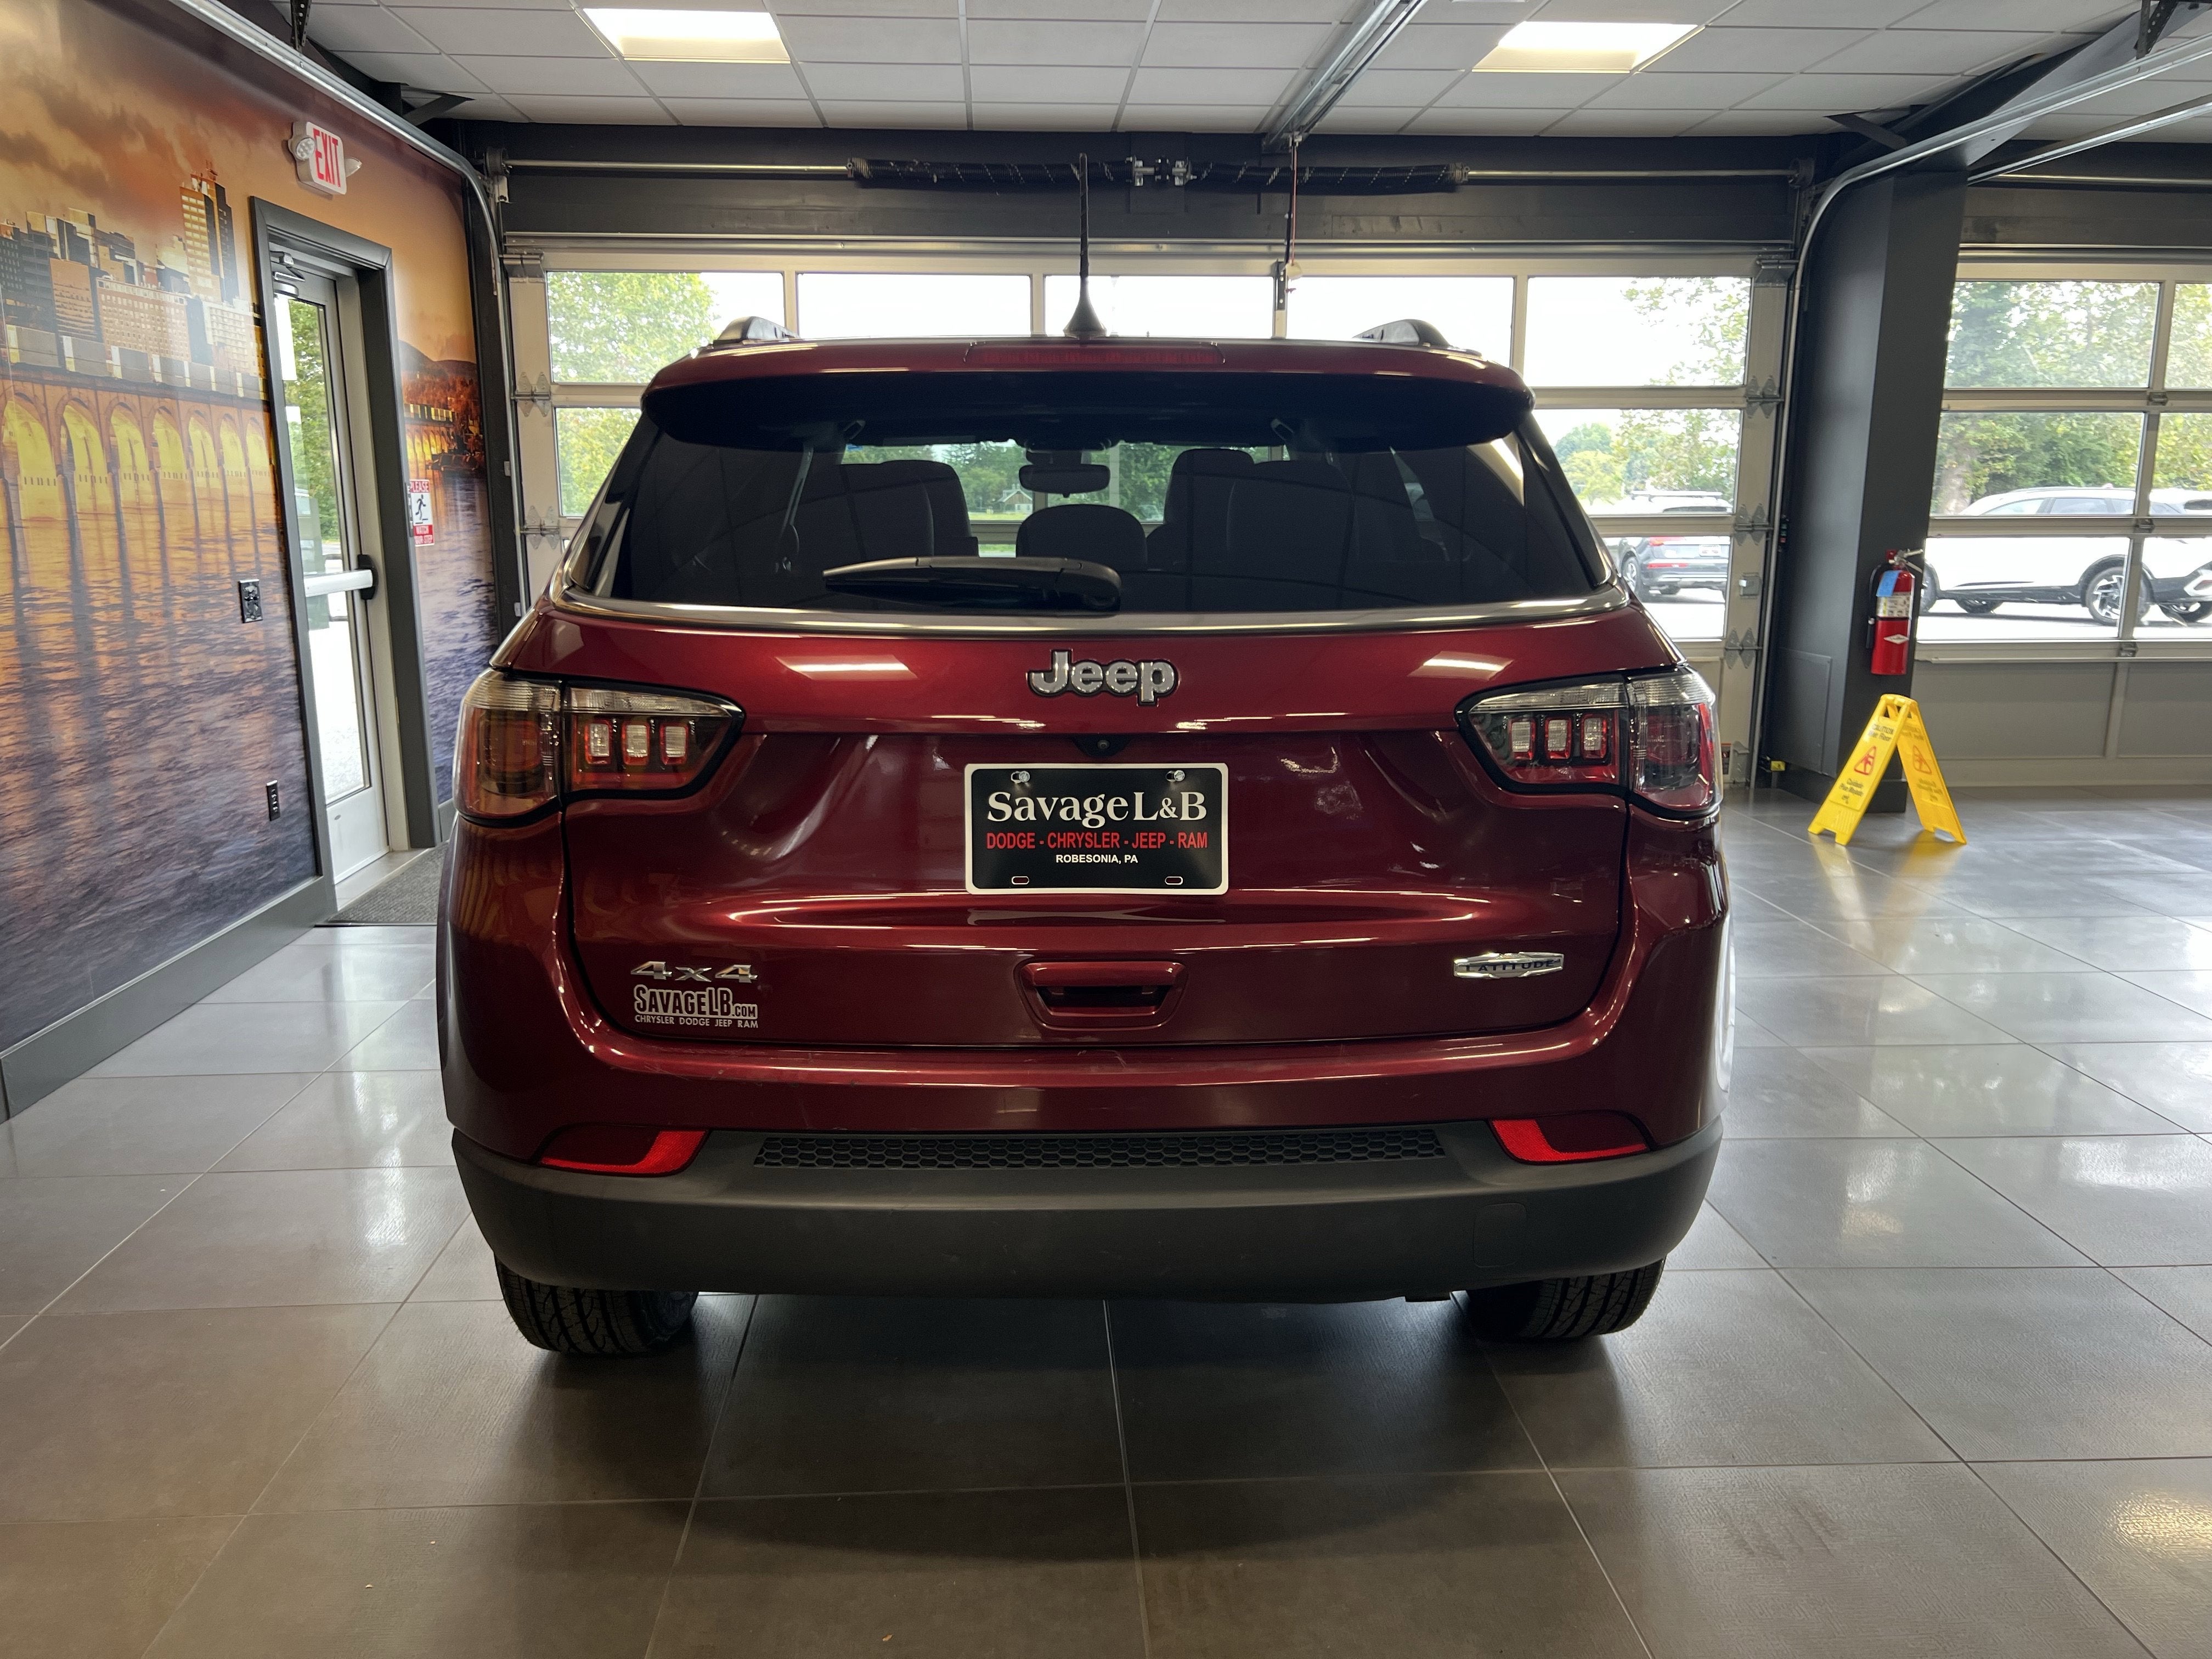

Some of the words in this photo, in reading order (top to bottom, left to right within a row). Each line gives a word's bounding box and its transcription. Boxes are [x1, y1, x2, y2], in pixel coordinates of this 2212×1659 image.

[313, 128, 341, 188] EXIT
[410, 481, 428, 492] PLEASE
[1028, 650, 1177, 704] Jeep
[986, 832, 1036, 849] DODGE
[1047, 832, 1120, 849] CHRYSLER
[1131, 832, 1166, 849] JEEP
[1177, 831, 1208, 849] RAM
[1056, 854, 1122, 864] ROBESONIA,
[1124, 854, 1138, 864] PA
[634, 1014, 675, 1024] CHRYSLER
[679, 1017, 710, 1026] DODGE
[715, 1019, 732, 1027] JEEP
[737, 1019, 759, 1028] RAM
